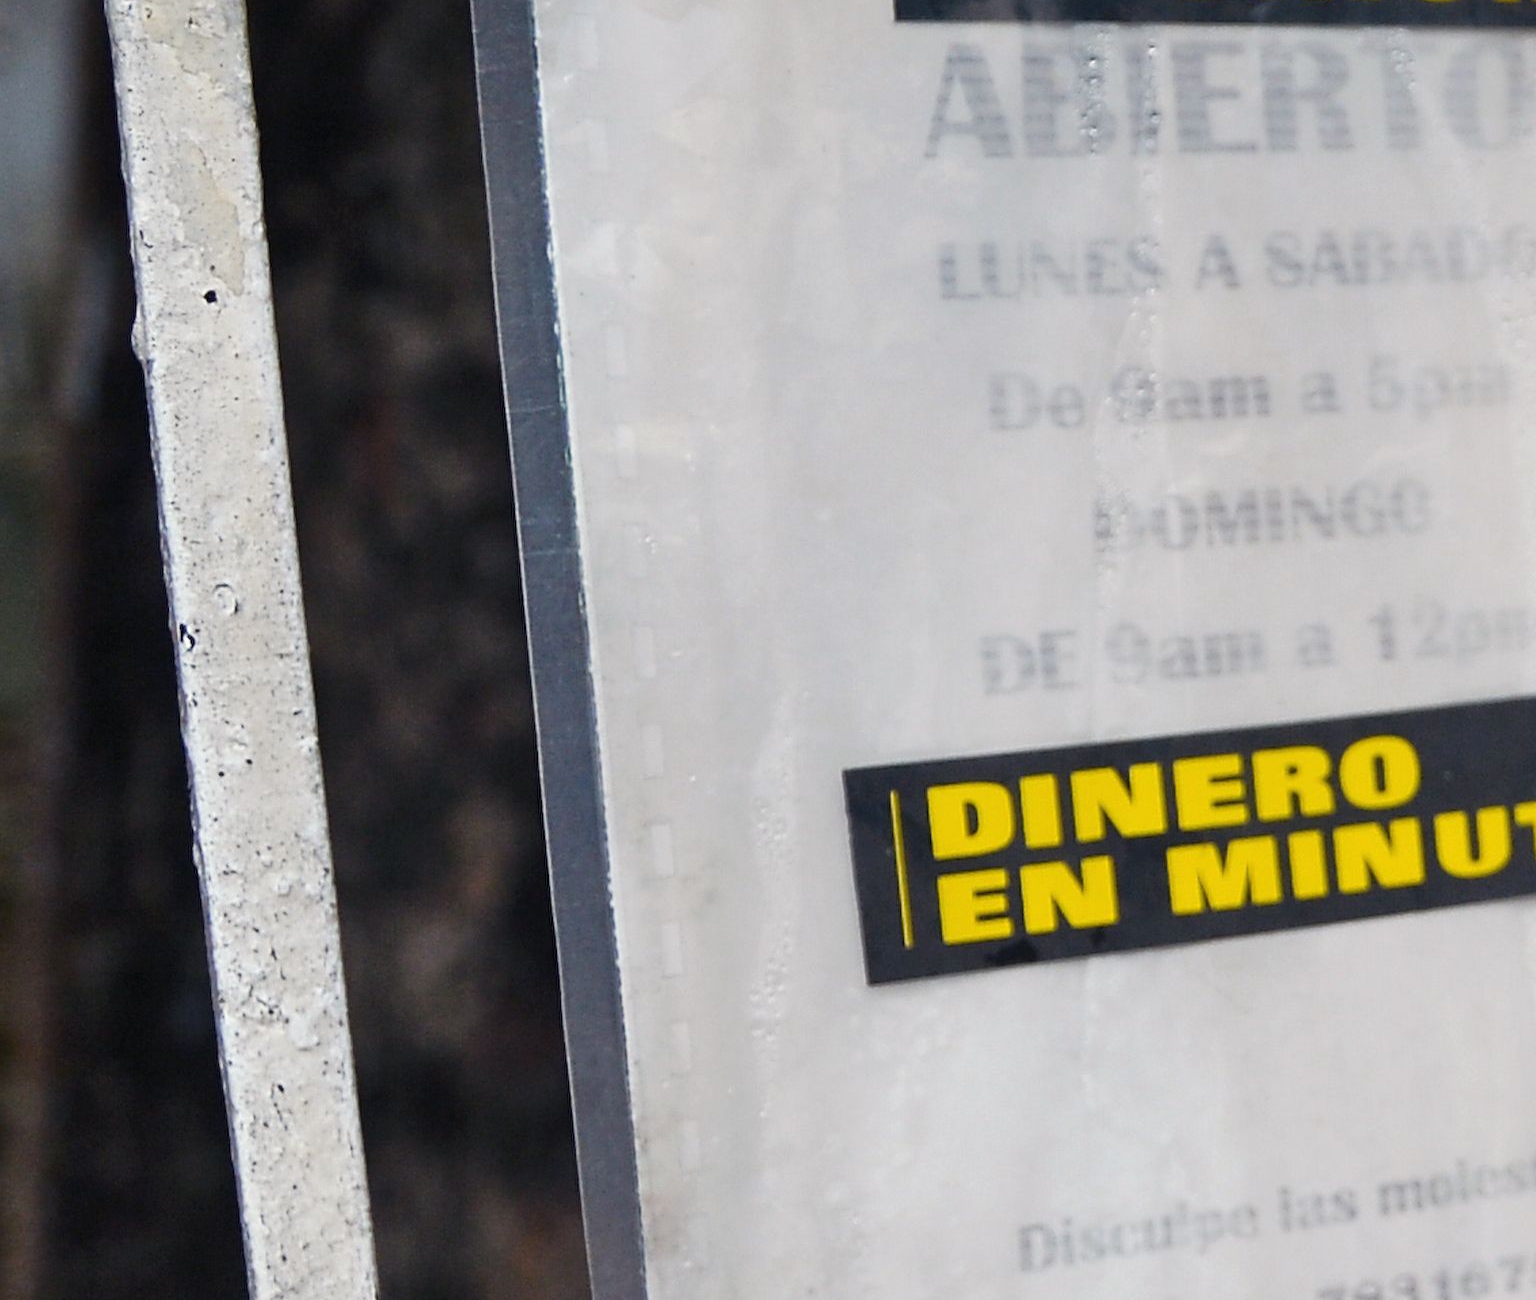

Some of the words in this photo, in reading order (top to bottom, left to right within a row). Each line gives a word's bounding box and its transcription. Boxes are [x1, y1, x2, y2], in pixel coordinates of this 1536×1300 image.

[936, 234, 1166, 303] LUNES
[1197, 233, 1243, 292] A
[988, 372, 1089, 432] De
[1106, 365, 1273, 424] 9am
[1300, 371, 1343, 415] a
[1366, 353, 1516, 420] 5pm
[1093, 478, 1431, 558] DOMINGO
[981, 628, 1078, 697] DE
[1104, 618, 1267, 685] 9am
[1296, 623, 1337, 672] a
[926, 734, 1424, 861] DINERO
[936, 859, 1120, 946] EN
[1014, 1198, 1262, 1275] Disculpe
[1276, 1183, 1360, 1233] las
